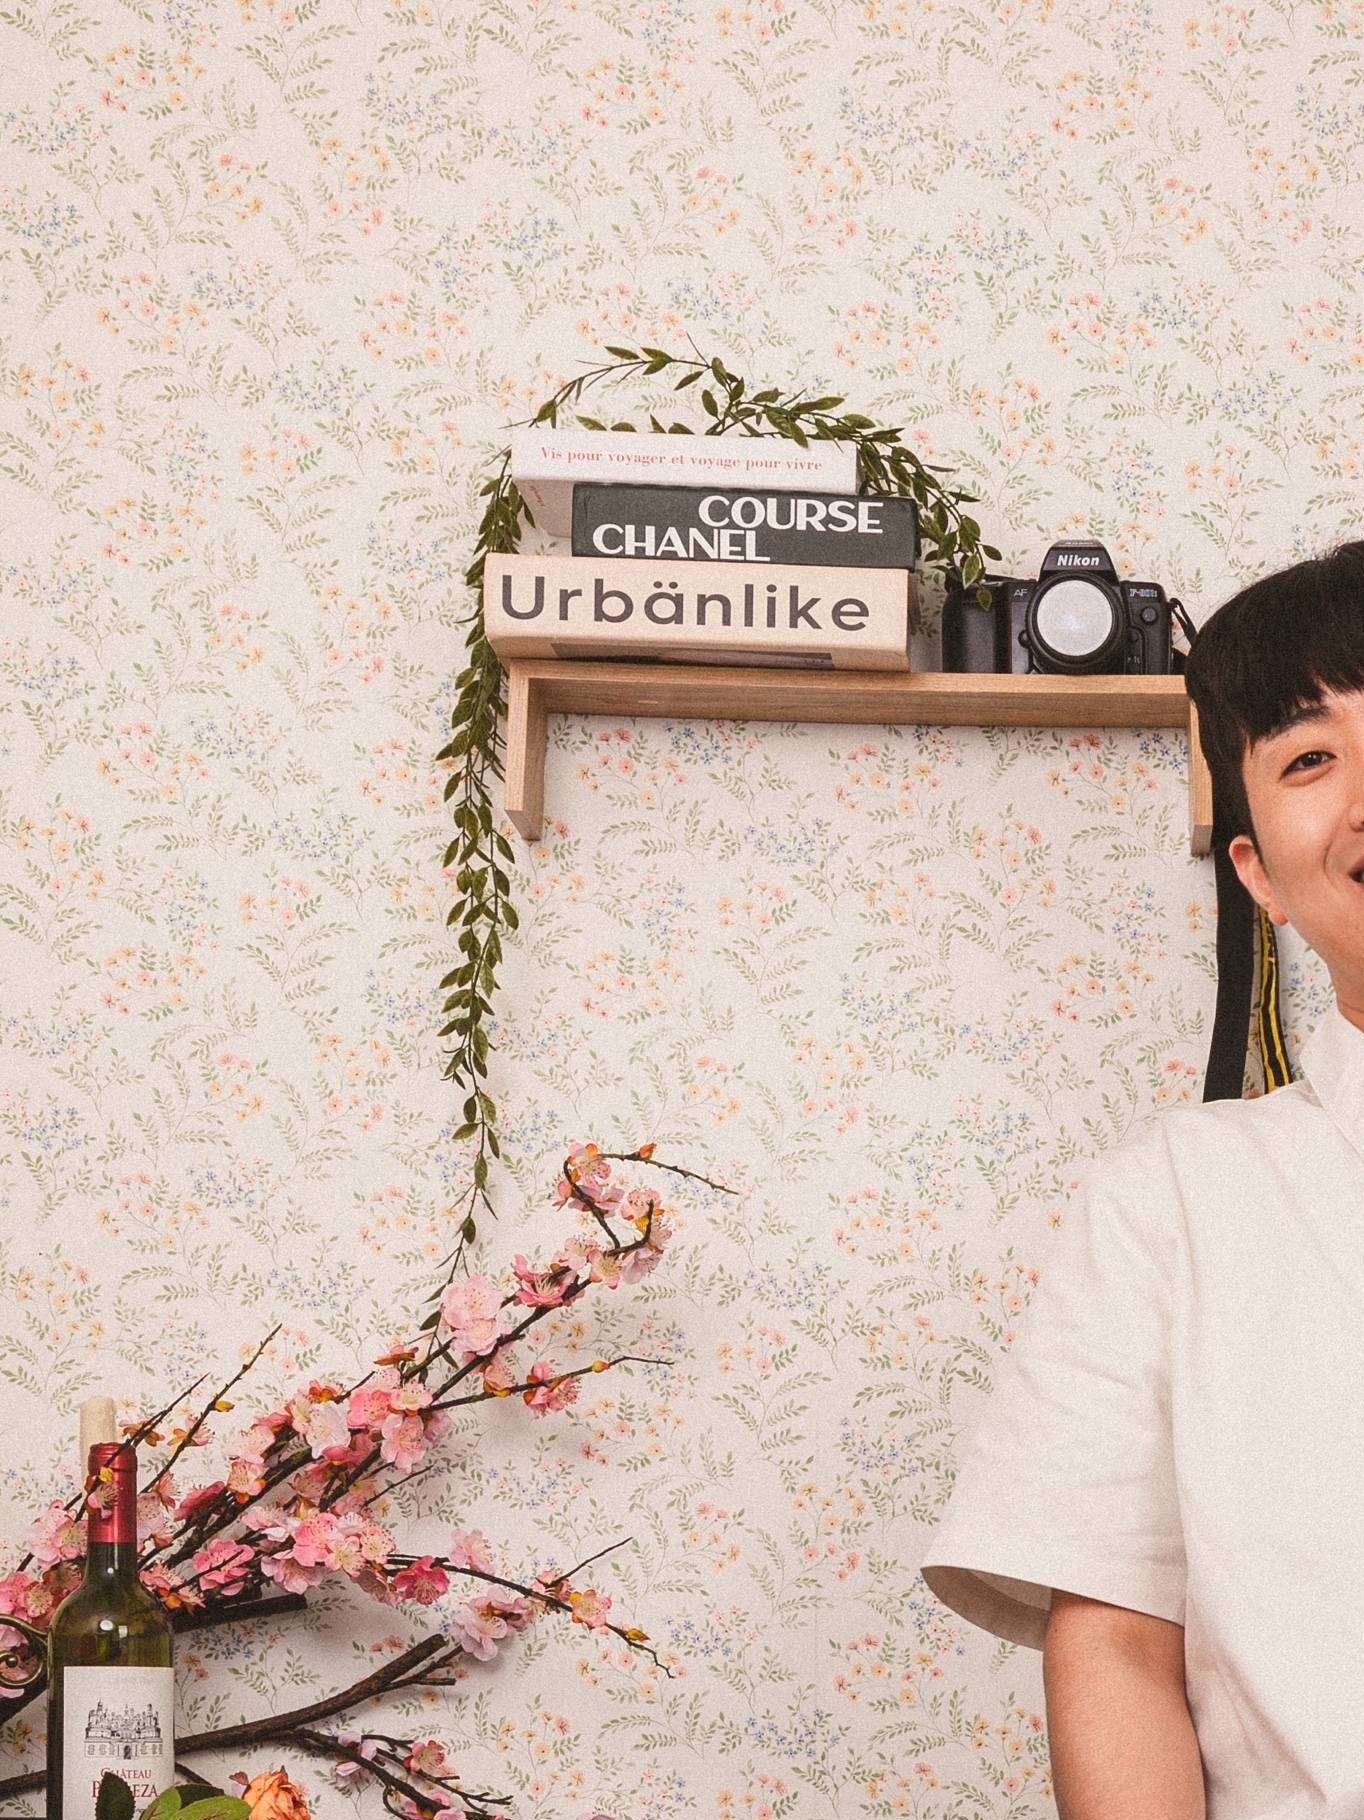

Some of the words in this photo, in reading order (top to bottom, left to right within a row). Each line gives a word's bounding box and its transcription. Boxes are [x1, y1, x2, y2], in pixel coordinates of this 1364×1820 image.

[541, 446, 562, 459] Vis
[567, 450, 603, 464] pour
[608, 453, 666, 467] voyager
[671, 456, 685, 465] et
[690, 457, 740, 471] voyage
[746, 459, 781, 473] pour
[786, 460, 822, 471] vivre
[699, 495, 884, 534] COURSE
[592, 523, 770, 562] CHANEL
[1057, 554, 1100, 566] Nikon
[501, 574, 870, 631] Urbänlike
[1013, 588, 1028, 597] AF
